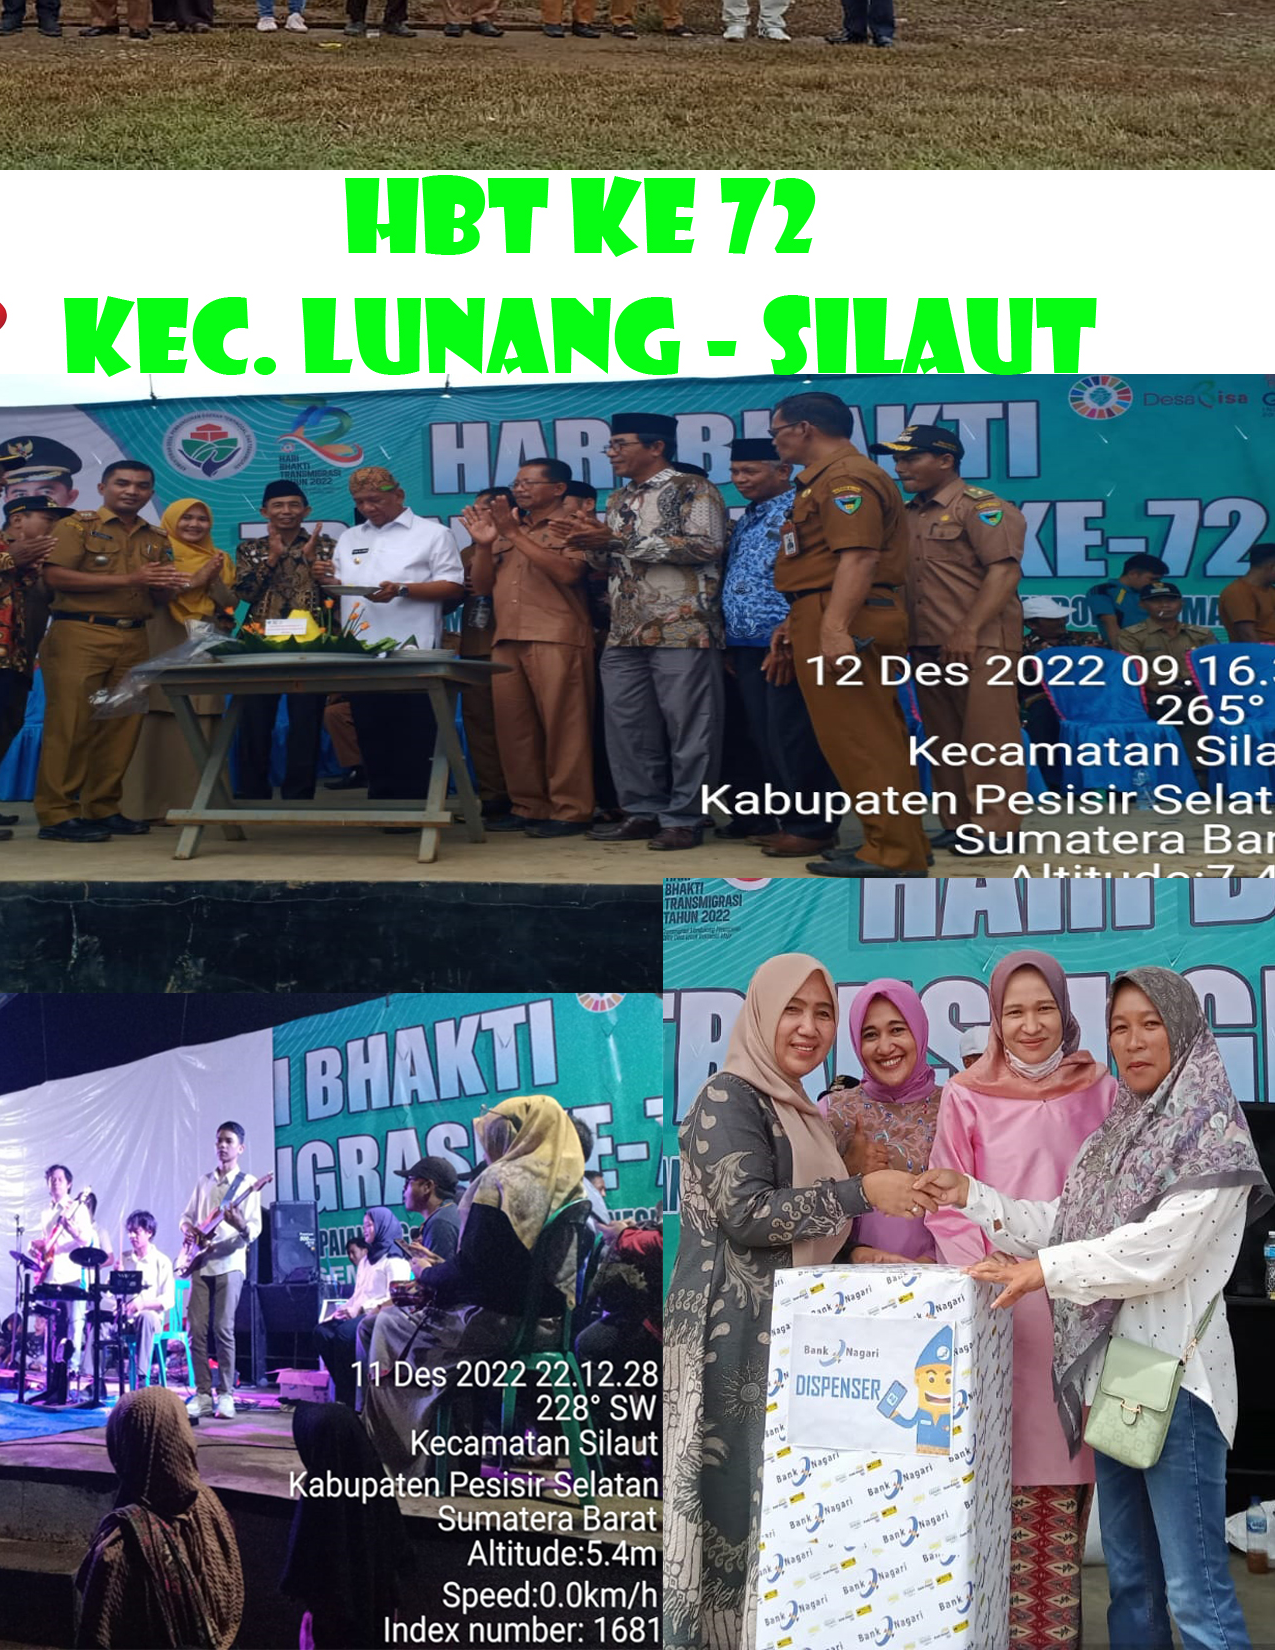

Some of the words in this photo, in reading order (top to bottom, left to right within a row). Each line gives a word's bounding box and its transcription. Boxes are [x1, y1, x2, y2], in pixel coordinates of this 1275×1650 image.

[279, 455, 299, 463] HARI
[279, 462, 311, 470] BHAKTI
[279, 470, 342, 478] TRANSMIGRASI
[309, 478, 333, 486] 2022
[665, 882, 704, 896] BHAKTI
[665, 894, 743, 911] TRANSMIGRASI
[664, 911, 699, 924] TAHUN
[701, 909, 731, 923] 2022
[305, 998, 559, 1122] BHAKTI
[845, 1286, 873, 1303] Nagari
[935, 1293, 966, 1313] Nagari
[804, 1345, 829, 1356] Bank
[845, 1348, 880, 1360] Nagari
[795, 1374, 881, 1401] DISPENSER
[776, 1468, 799, 1484] Bank
[811, 1451, 840, 1469] Nagari
[867, 1481, 891, 1497] Bank
[902, 1463, 934, 1482] Nagari
[824, 1496, 854, 1515] Nagari
[857, 1628, 882, 1643] Bank
[893, 1612, 924, 1630] Nagari
